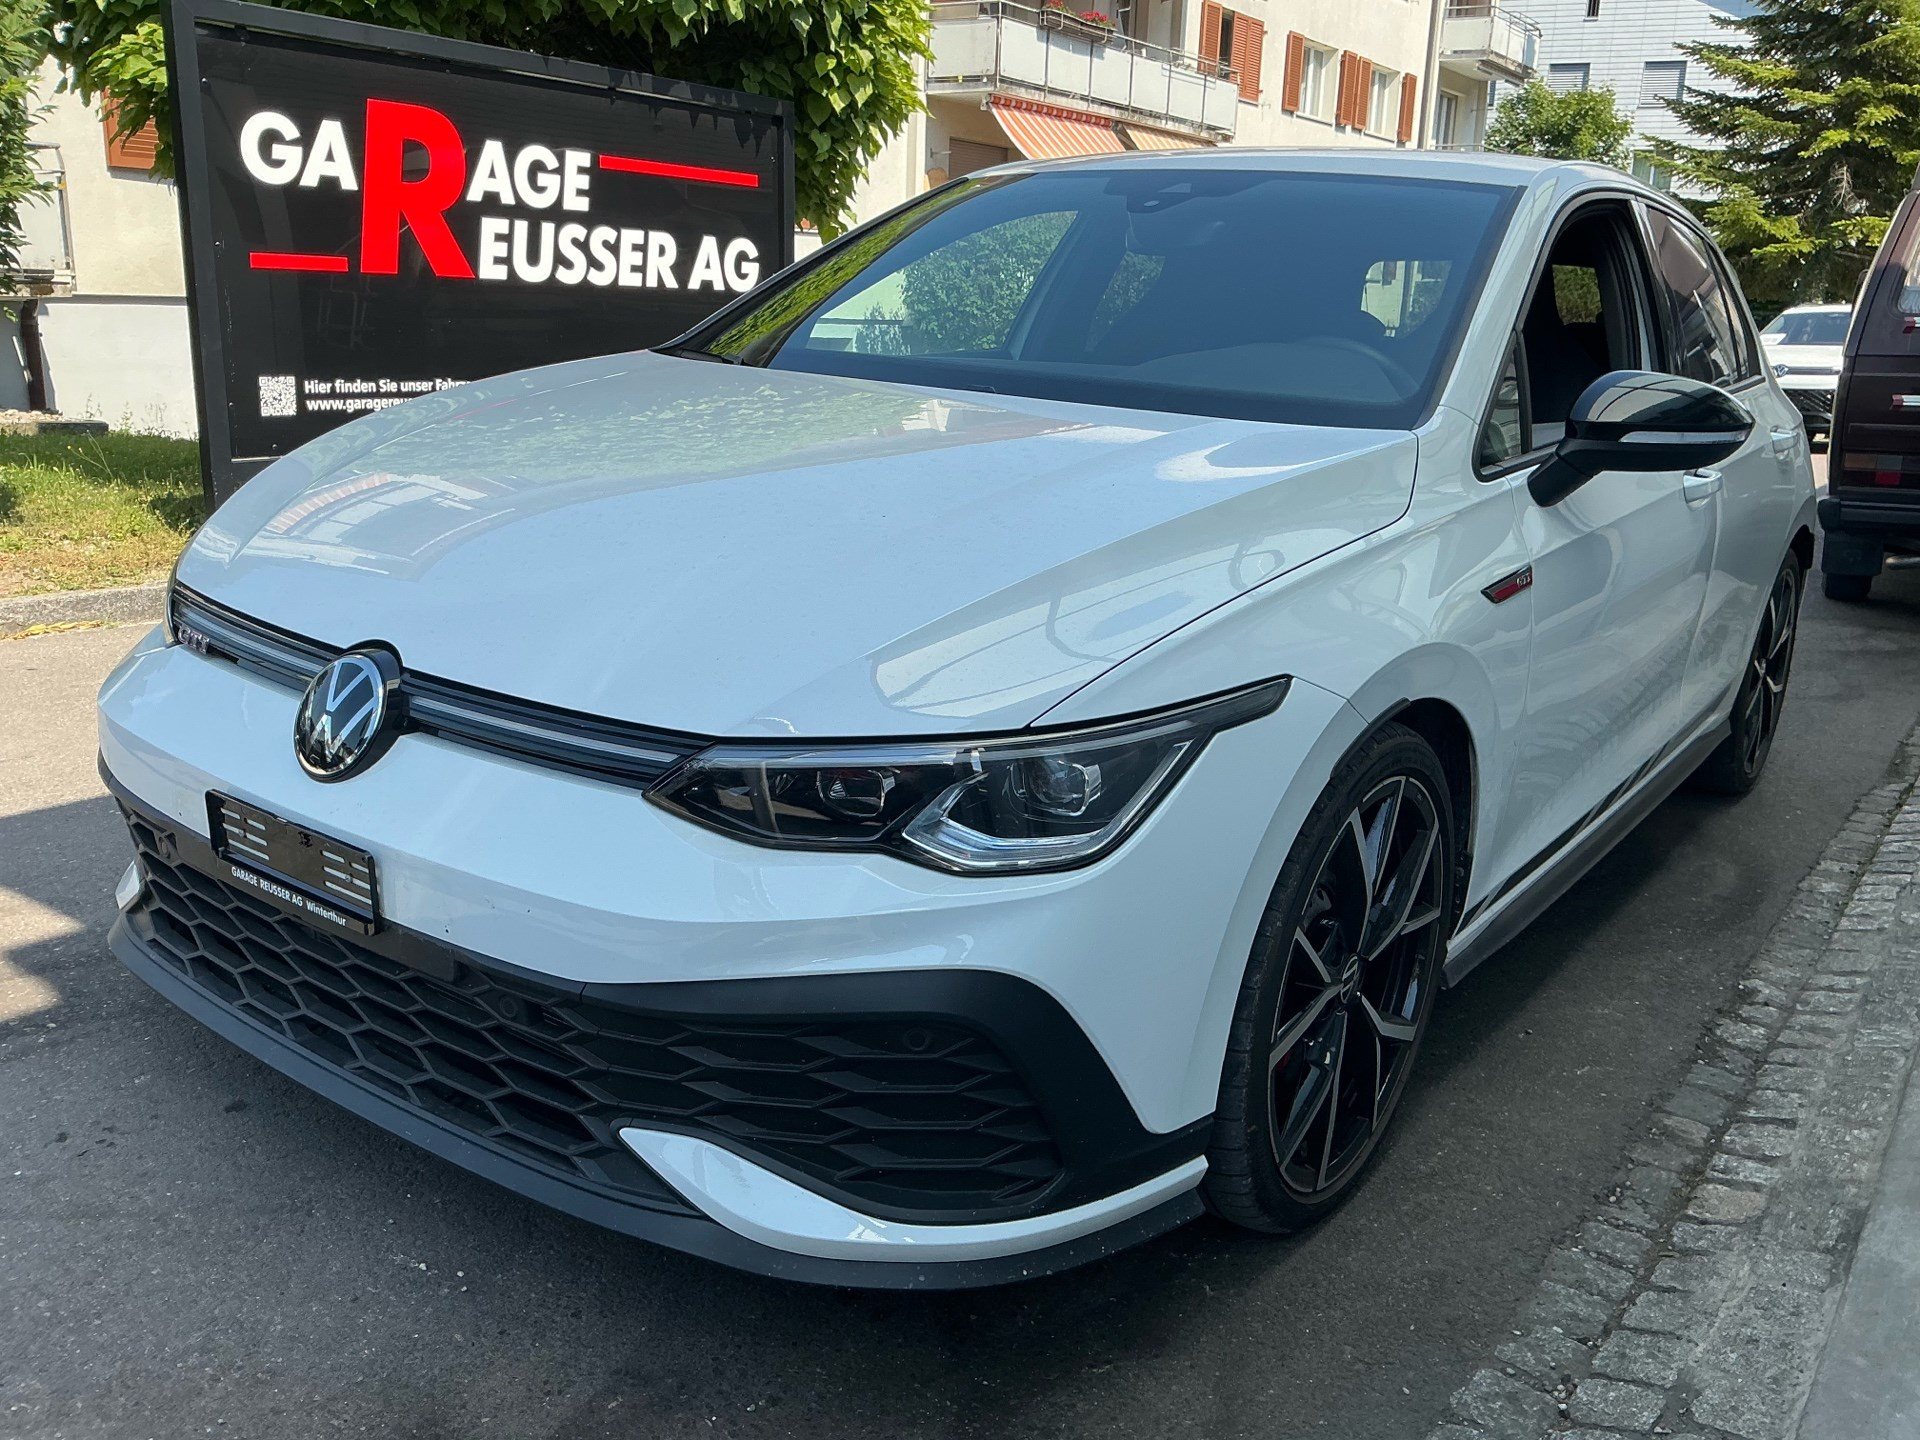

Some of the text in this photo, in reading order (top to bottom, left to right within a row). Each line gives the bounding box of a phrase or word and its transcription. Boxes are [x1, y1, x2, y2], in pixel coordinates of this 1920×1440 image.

[687, 235, 760, 292] AG
[304, 380, 332, 394] Hier
[334, 378, 377, 393] finden
[378, 378, 398, 392] Sie
[400, 380, 433, 392] unser
[178, 624, 209, 654] GTI
[231, 866, 347, 926] GARAGE REUSSER AG Winterthur
